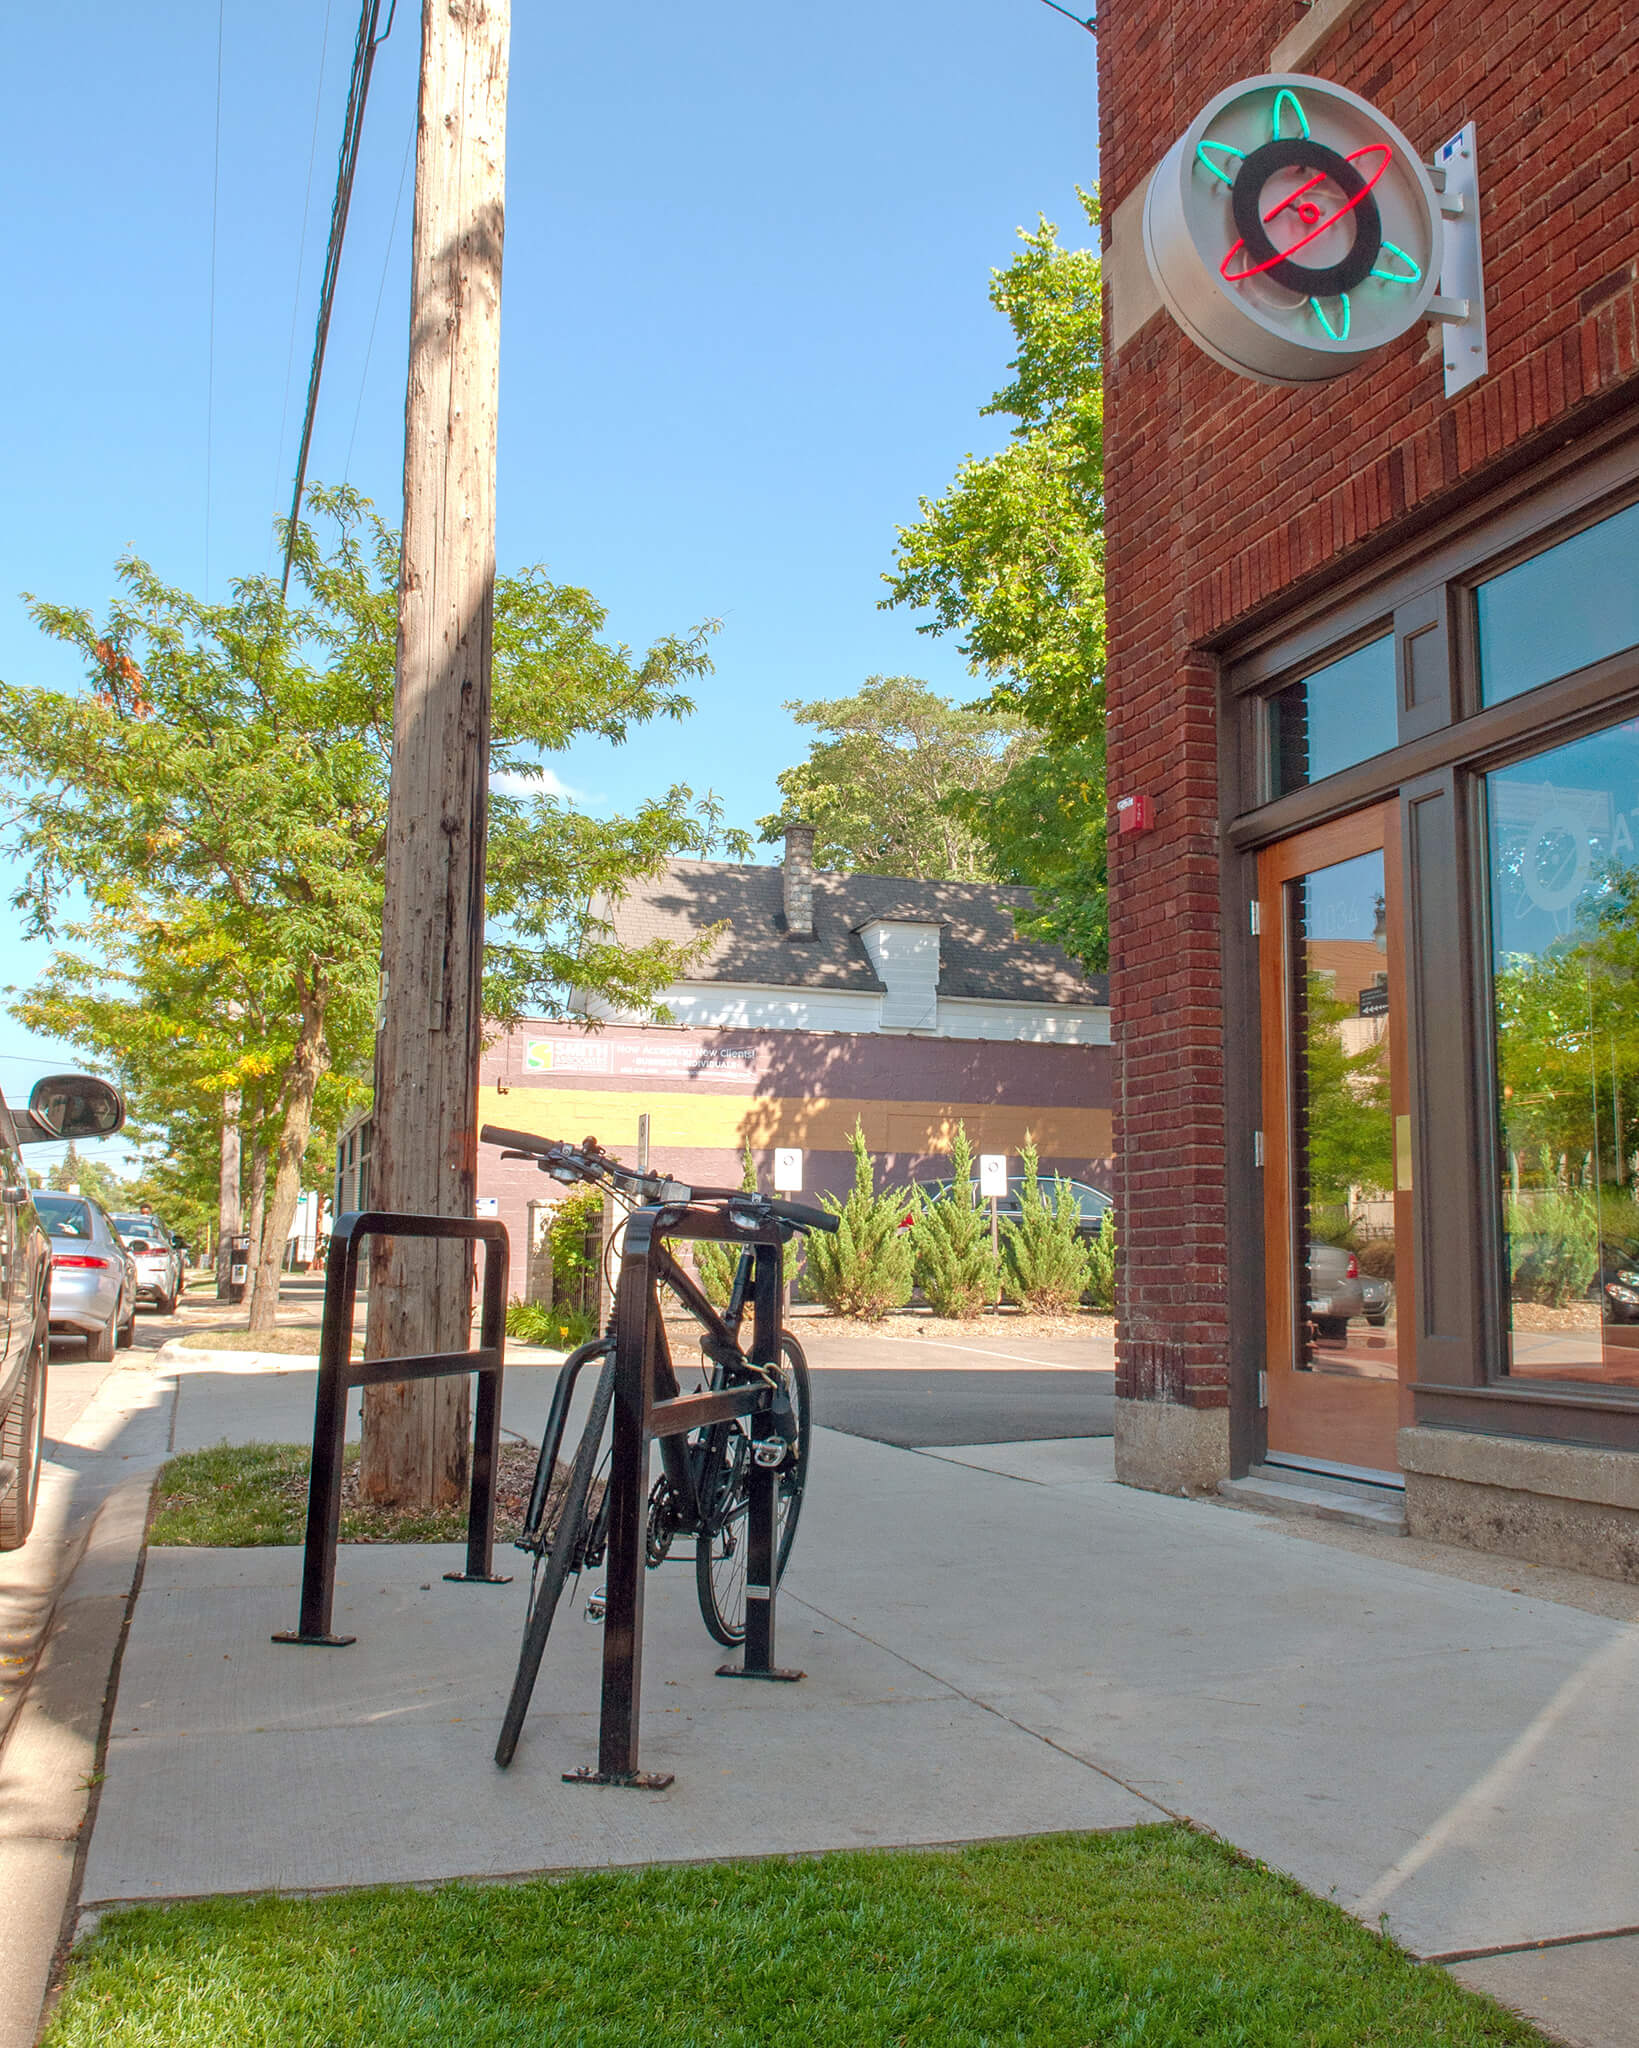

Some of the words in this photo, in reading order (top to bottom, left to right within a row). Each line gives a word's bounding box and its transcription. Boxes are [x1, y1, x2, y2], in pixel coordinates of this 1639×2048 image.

[555, 1042, 608, 1057] SMITH
[616, 1045, 640, 1054] Now
[642, 1045, 692, 1058] Accepting
[695, 1047, 718, 1057] New
[720, 1048, 755, 1059] Clients!
